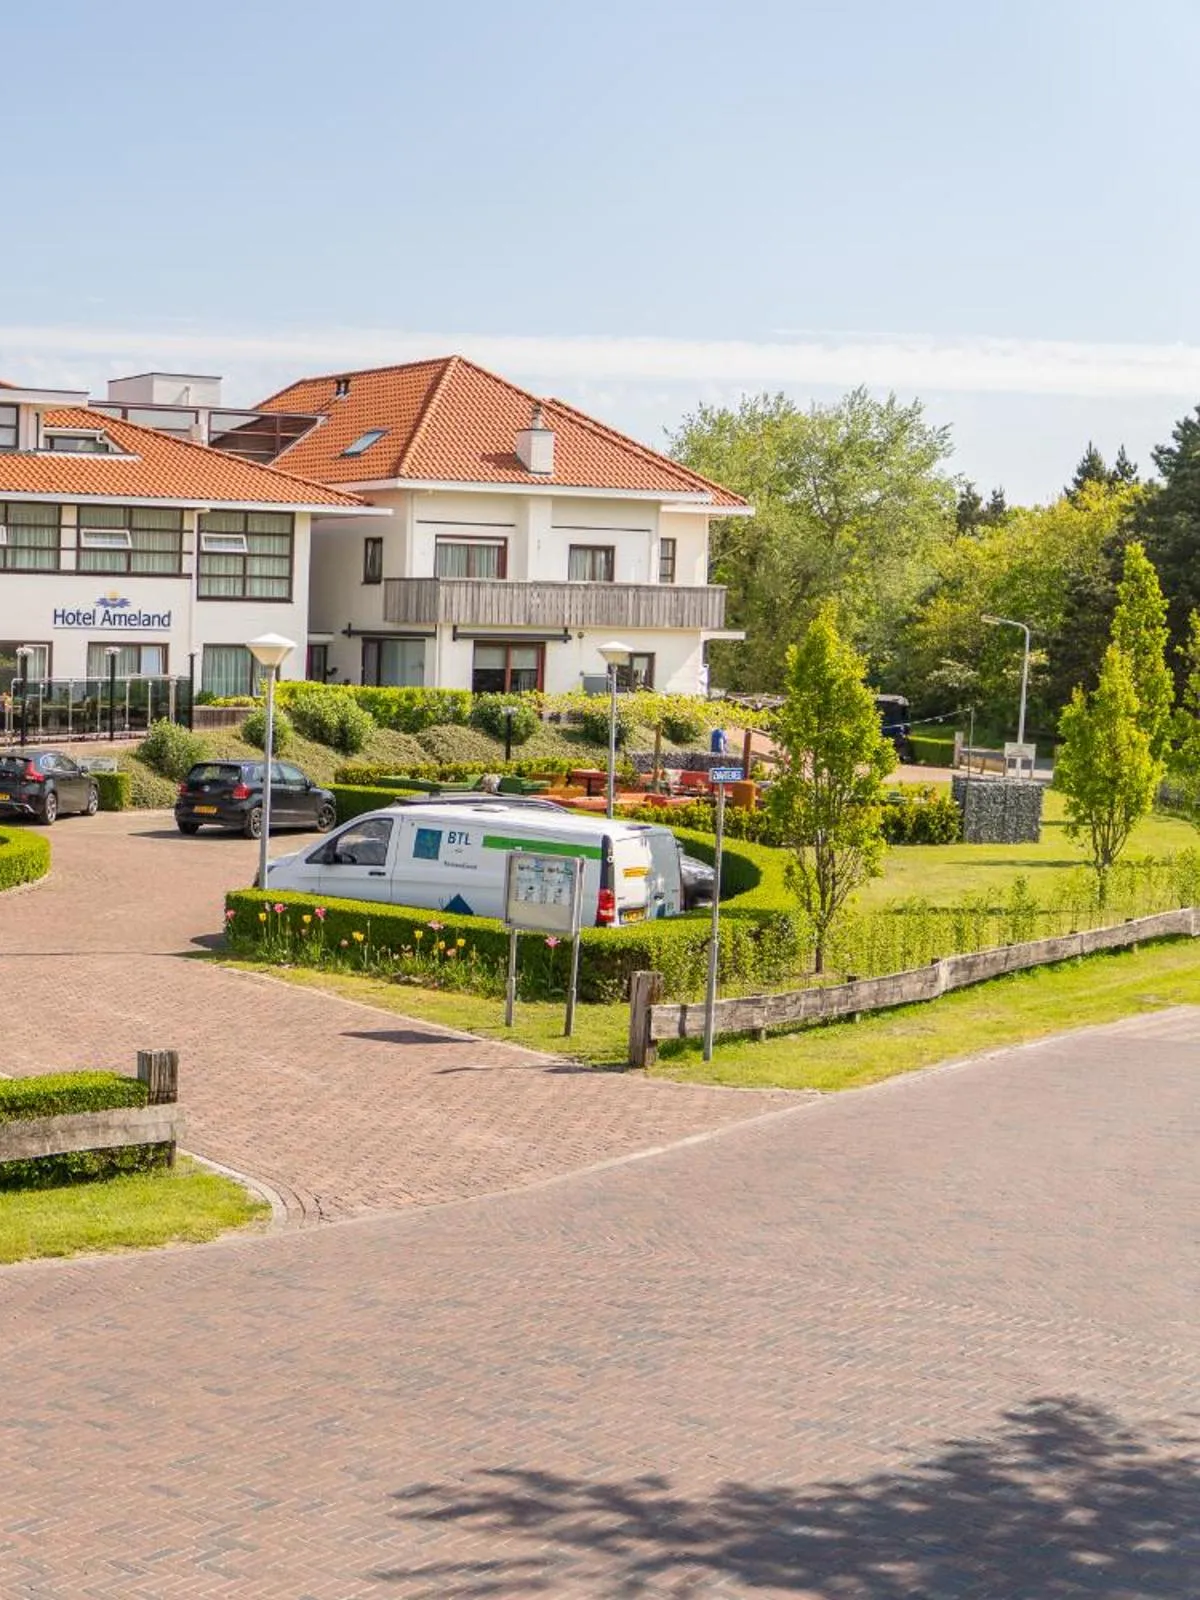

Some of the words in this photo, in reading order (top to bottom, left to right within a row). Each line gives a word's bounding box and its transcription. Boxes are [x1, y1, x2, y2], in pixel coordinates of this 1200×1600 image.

[53, 608, 96, 626] Hotel
[100, 608, 171, 627] Ameland
[447, 831, 472, 846] BTL
